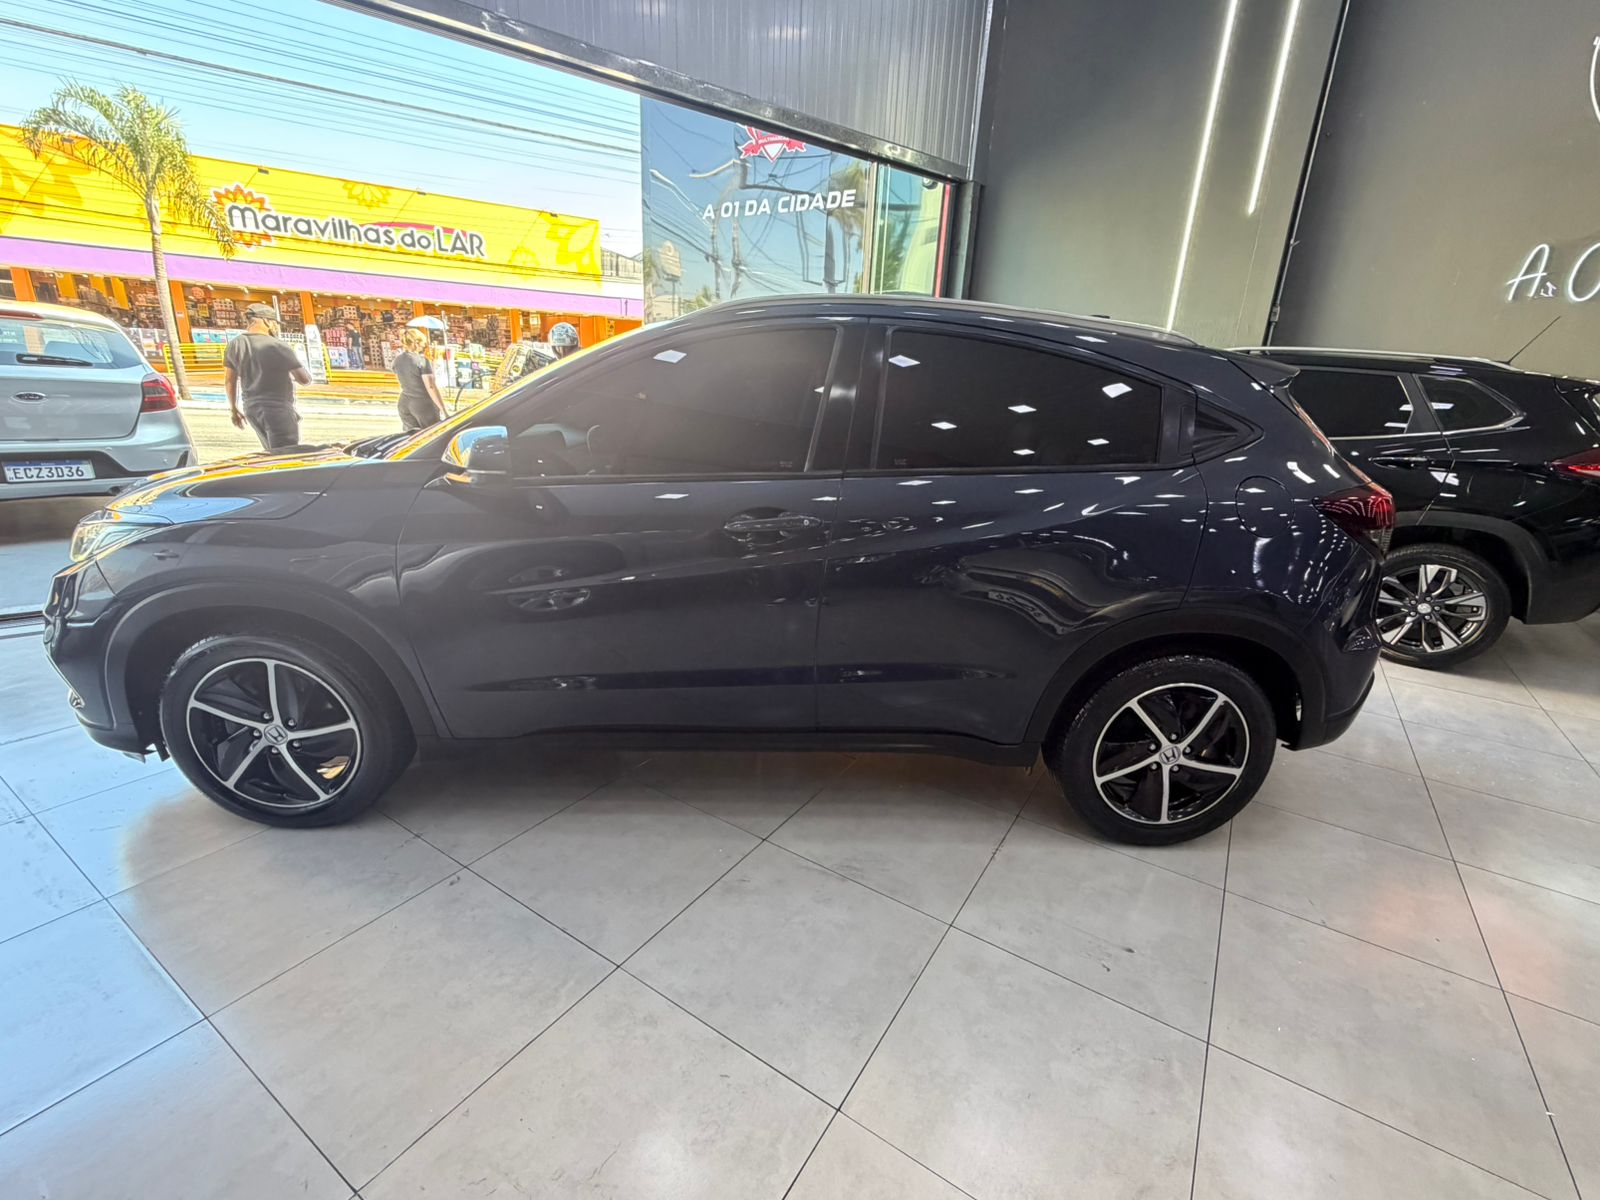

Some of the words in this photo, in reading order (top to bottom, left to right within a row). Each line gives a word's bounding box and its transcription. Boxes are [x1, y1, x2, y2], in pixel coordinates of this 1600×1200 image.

[702, 204, 715, 220] A
[744, 198, 771, 216] DA
[777, 189, 857, 214] CIDADE
[400, 230, 432, 250] do
[436, 228, 485, 257] LAR
[12, 466, 85, 480] ECZ3D36
